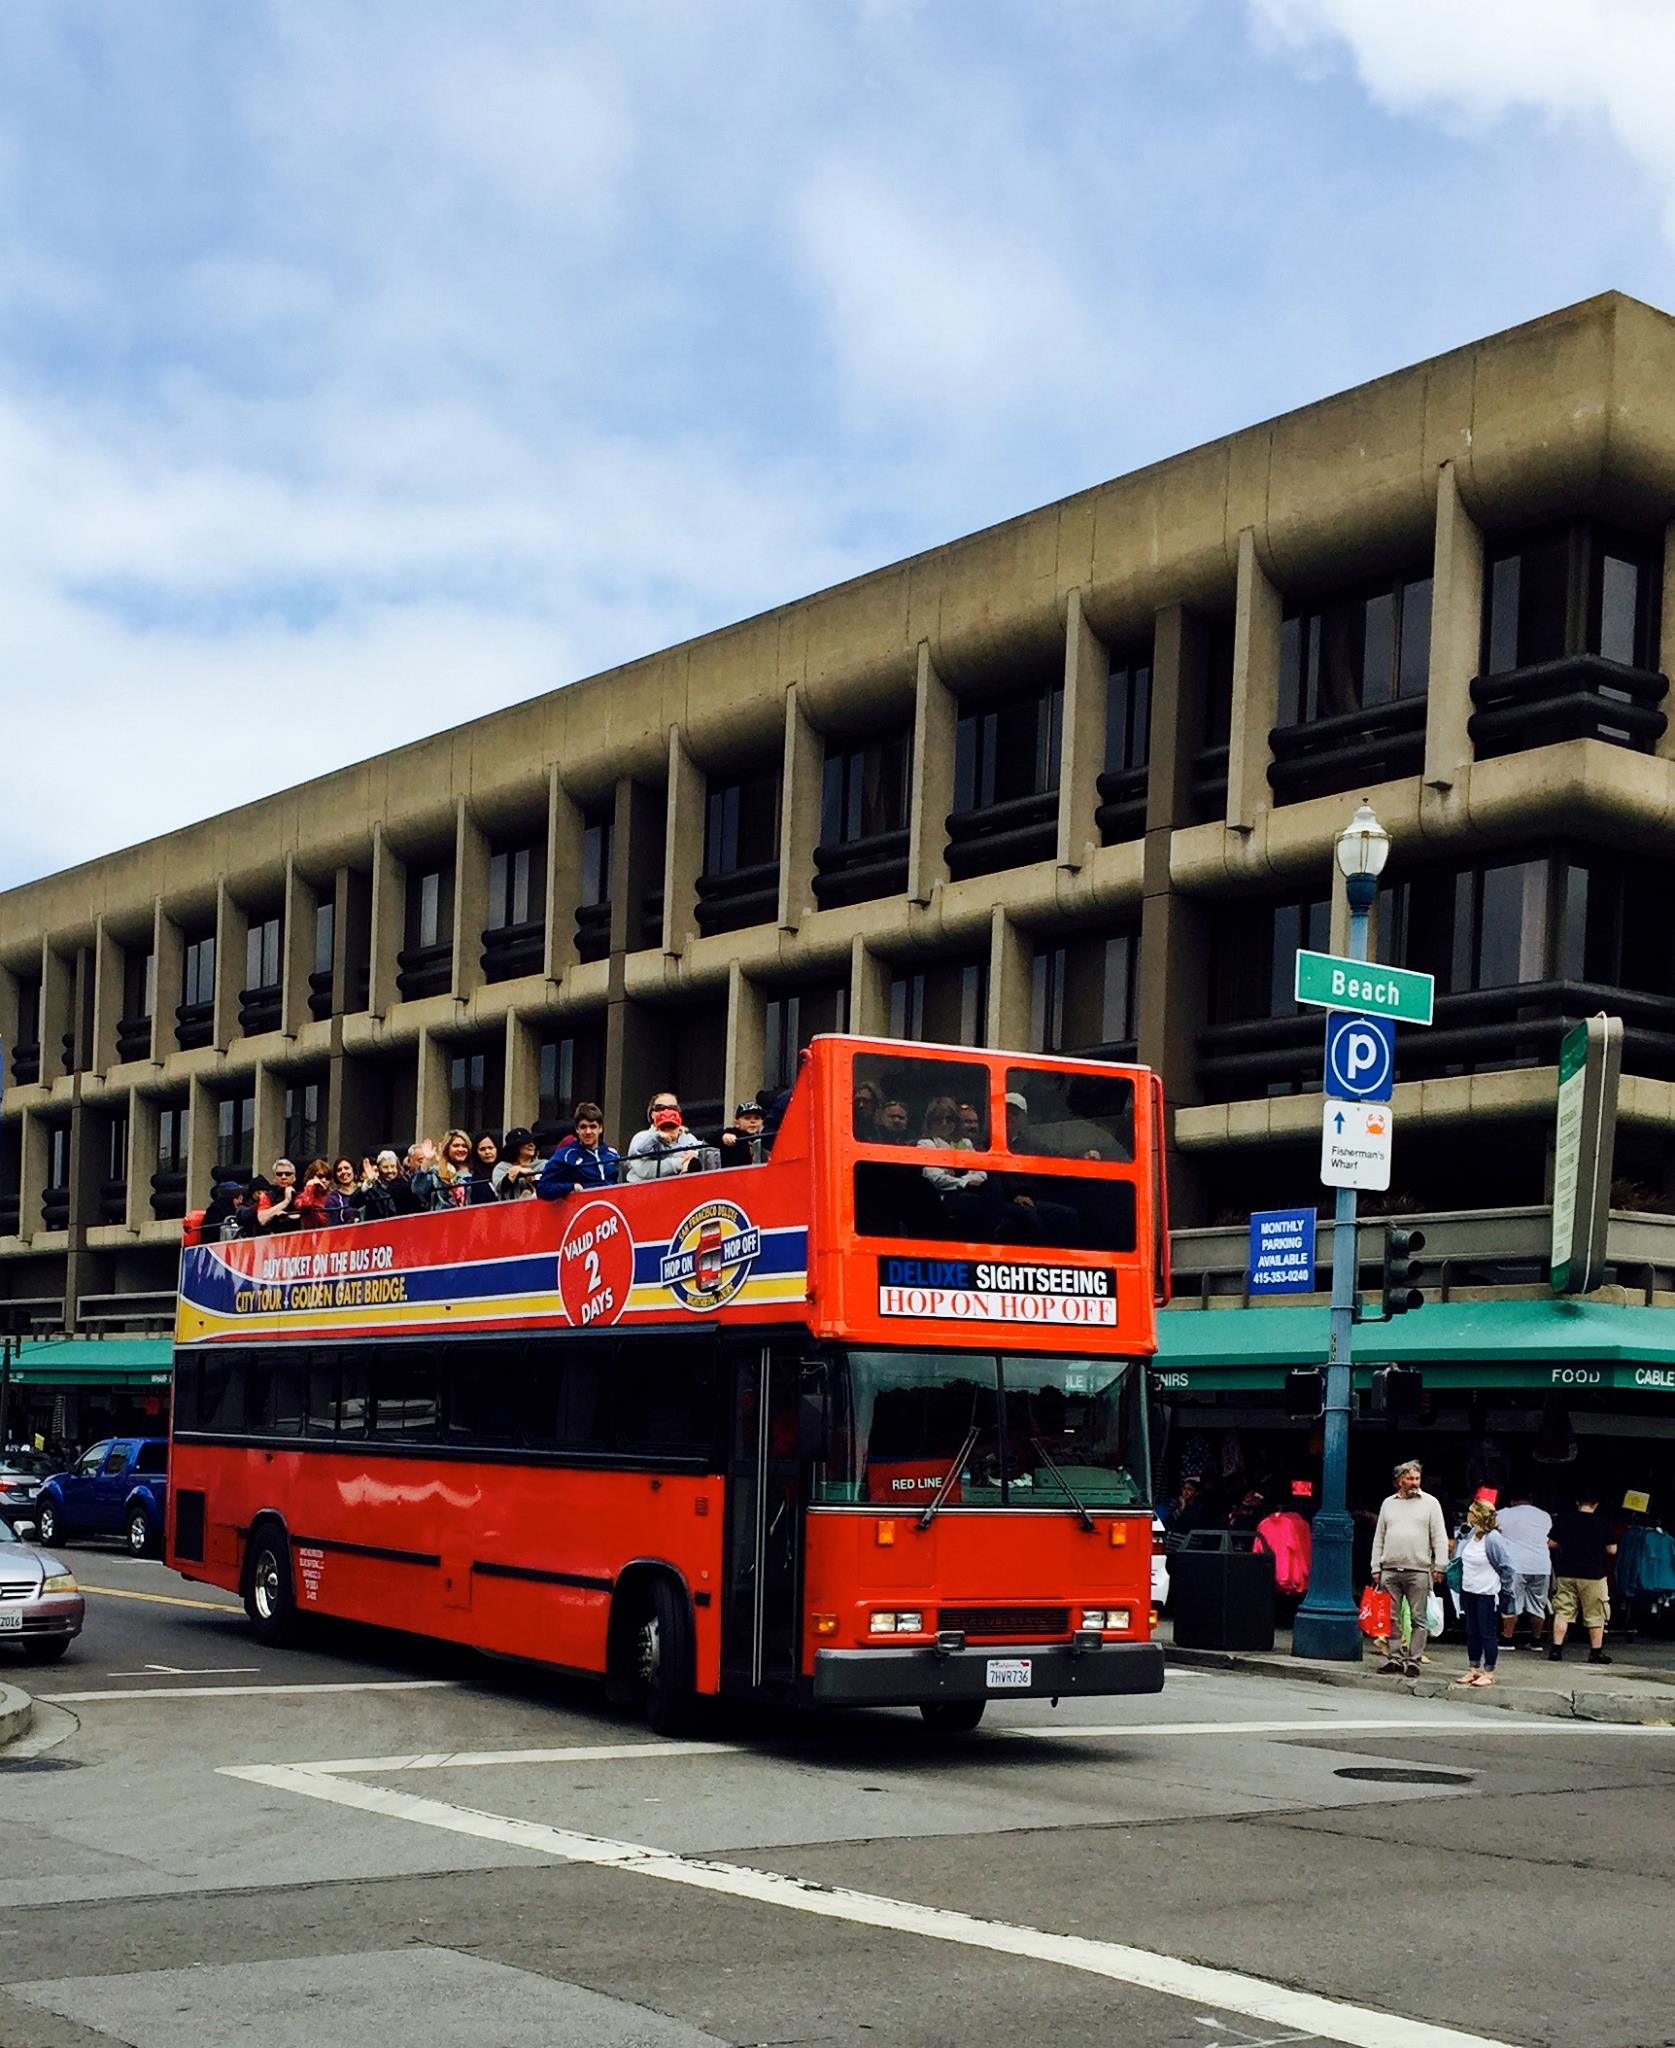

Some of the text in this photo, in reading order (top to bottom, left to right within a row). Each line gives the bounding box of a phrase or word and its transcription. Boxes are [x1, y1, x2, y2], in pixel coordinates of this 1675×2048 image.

[1332, 969, 1400, 1006] Beach
[1331, 1145, 1385, 1161] Fisherman's
[1331, 1158, 1358, 1169] Wharf
[679, 1225, 690, 1241] SAN
[1261, 1220, 1304, 1235] MONTHLY
[564, 1215, 619, 1262] VALID FOR
[723, 1234, 757, 1260] HOP OFF
[1262, 1236, 1303, 1251] PARKING
[263, 1246, 393, 1278] BUY TICKET ON THE BUS FOR
[664, 1255, 693, 1279] HOP ON
[1258, 1253, 1308, 1267] AVAILABLE
[584, 1250, 602, 1294] 2
[888, 1260, 1107, 1295] DELUXE SIGHTSEEING
[1253, 1269, 1309, 1284] 415-353-0240
[236, 1290, 255, 1313] CITY
[257, 1288, 282, 1311] TOUR
[291, 1283, 334, 1309] GOLDEN
[335, 1281, 363, 1306] GATE
[363, 1276, 408, 1303] BRIDGE.
[581, 1287, 613, 1325] DAYS
[885, 1289, 1113, 1323] HOP ON HOP OFF
[1551, 1369, 1601, 1383] FOOD
[1635, 1368, 1675, 1387] CABLE
[892, 1477, 942, 1490] RED LINE
[990, 1670, 1029, 1684] 7HVR736
